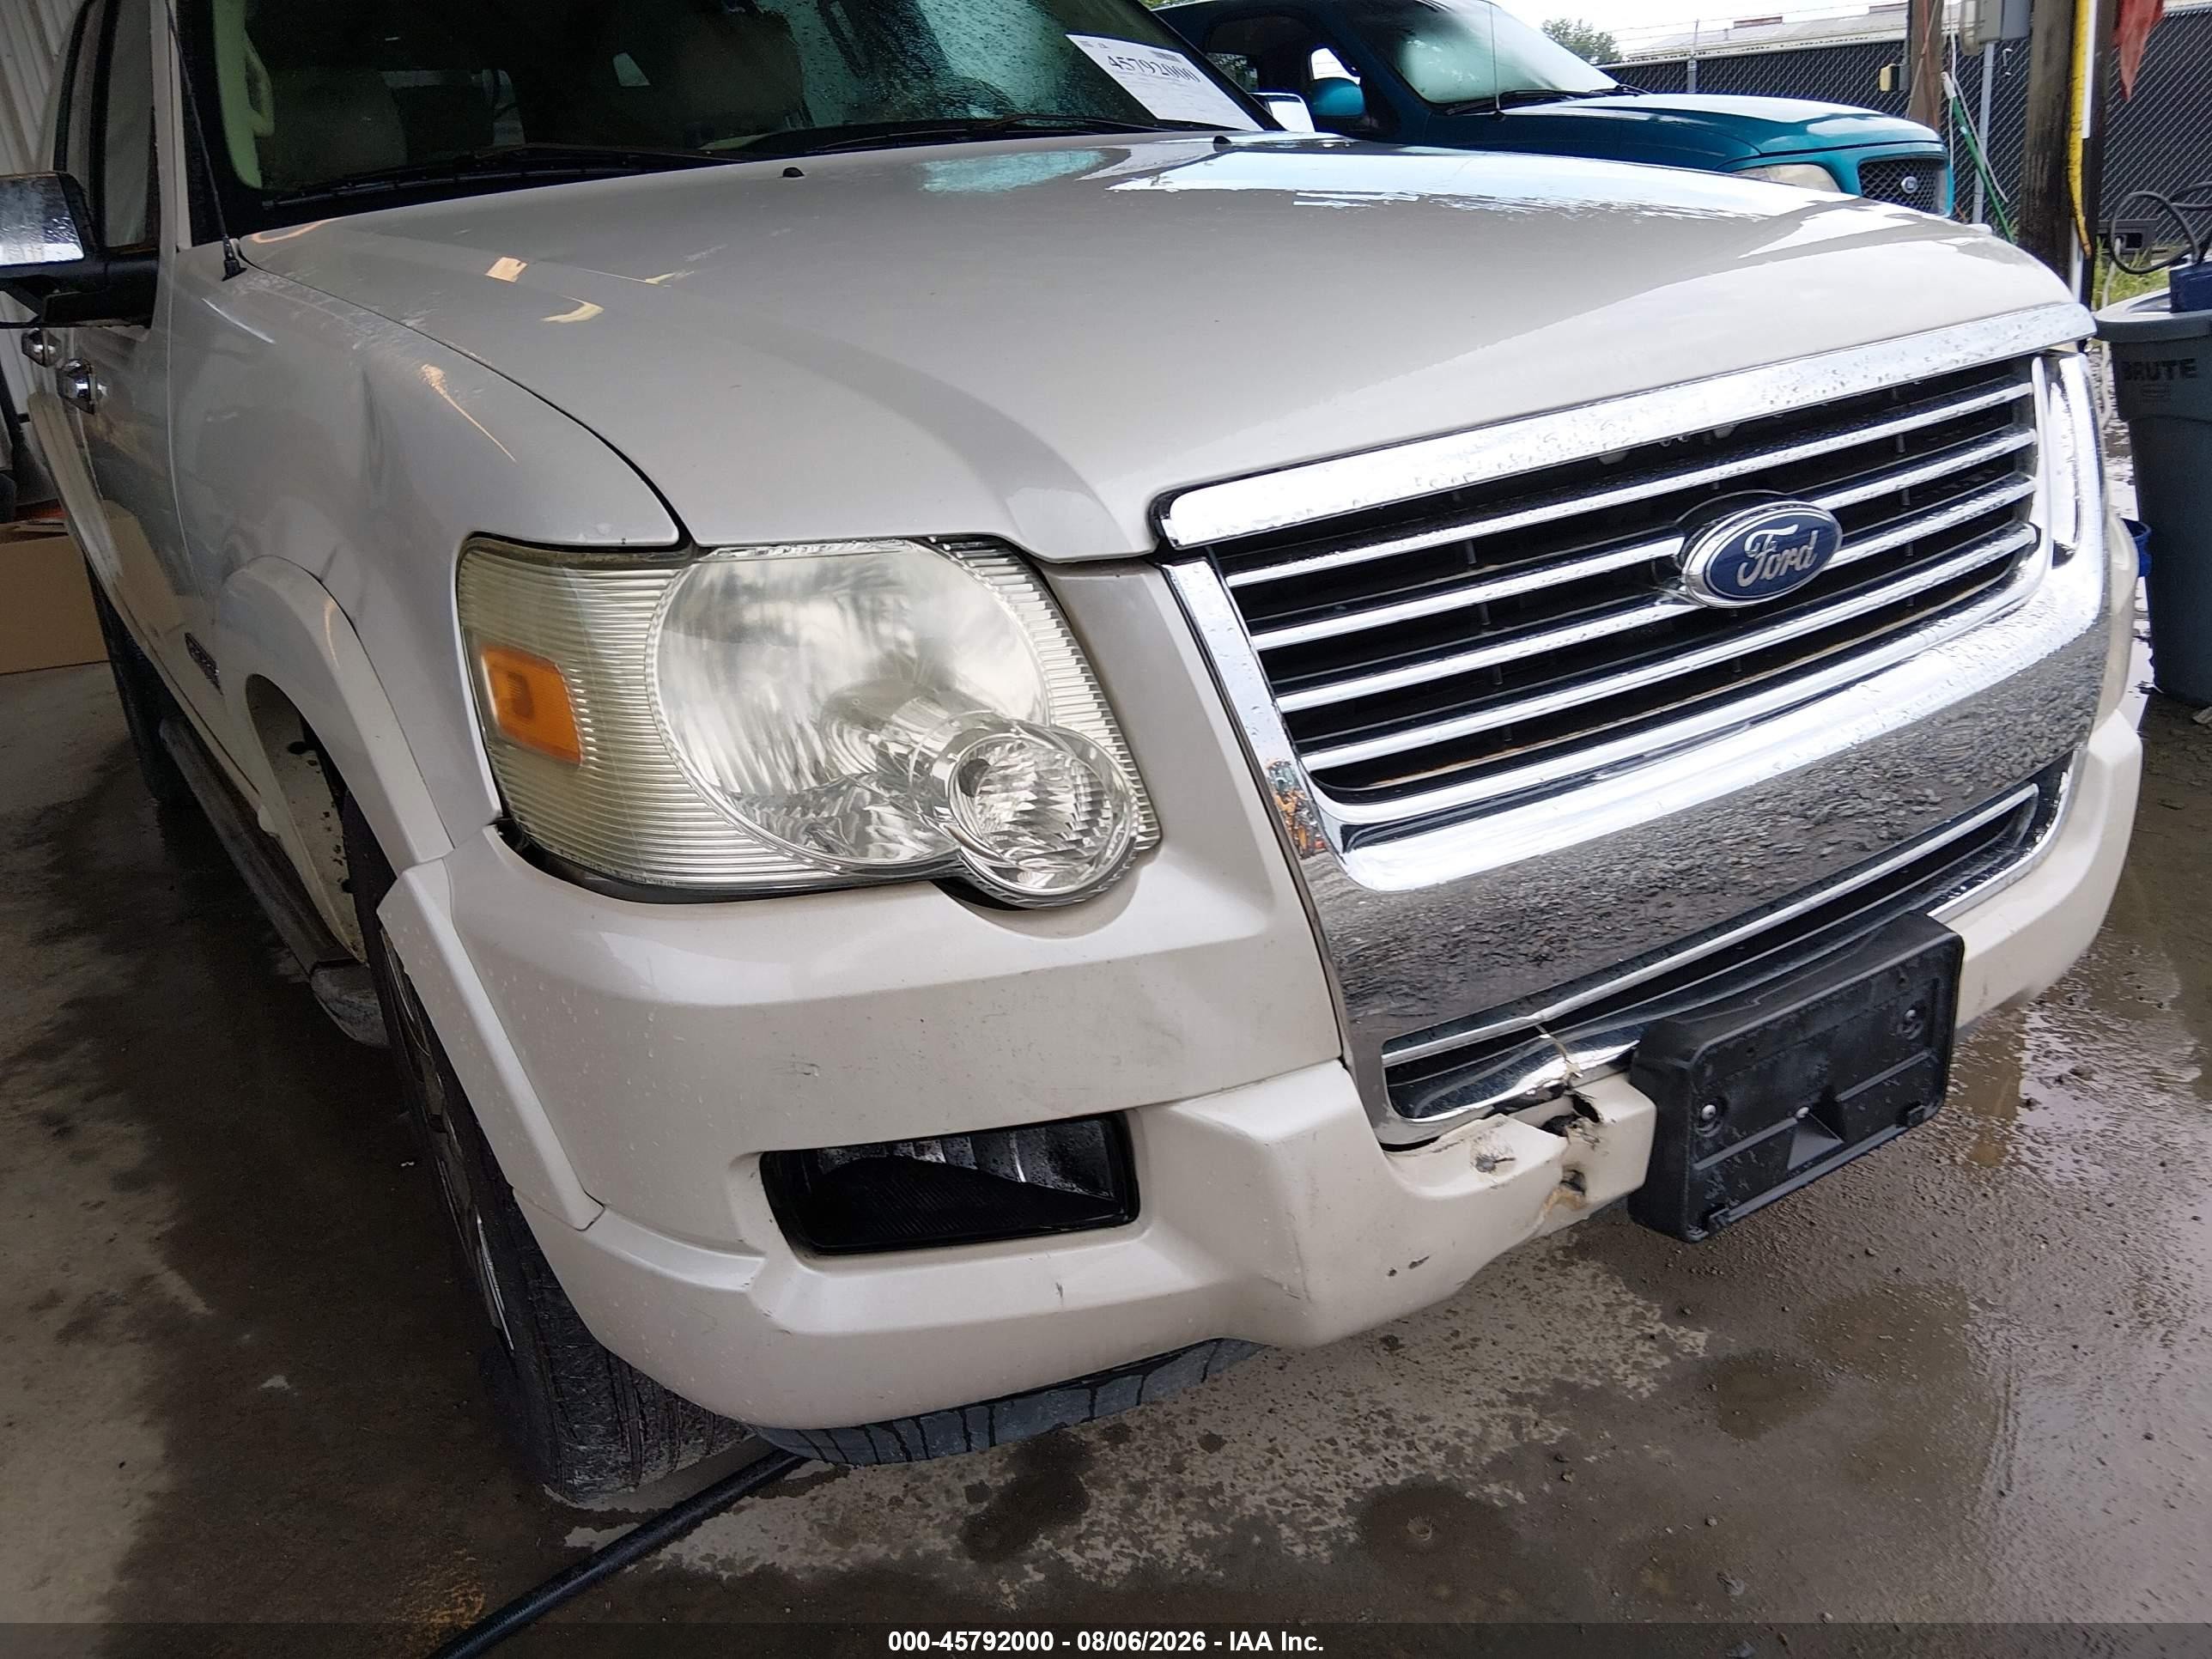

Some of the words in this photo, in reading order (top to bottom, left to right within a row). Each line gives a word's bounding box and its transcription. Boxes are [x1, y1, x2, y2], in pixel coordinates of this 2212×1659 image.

[1108, 55, 1200, 82] 45792000
[2122, 358, 2198, 381] BRUTE
[1736, 524, 1819, 587] Ford
